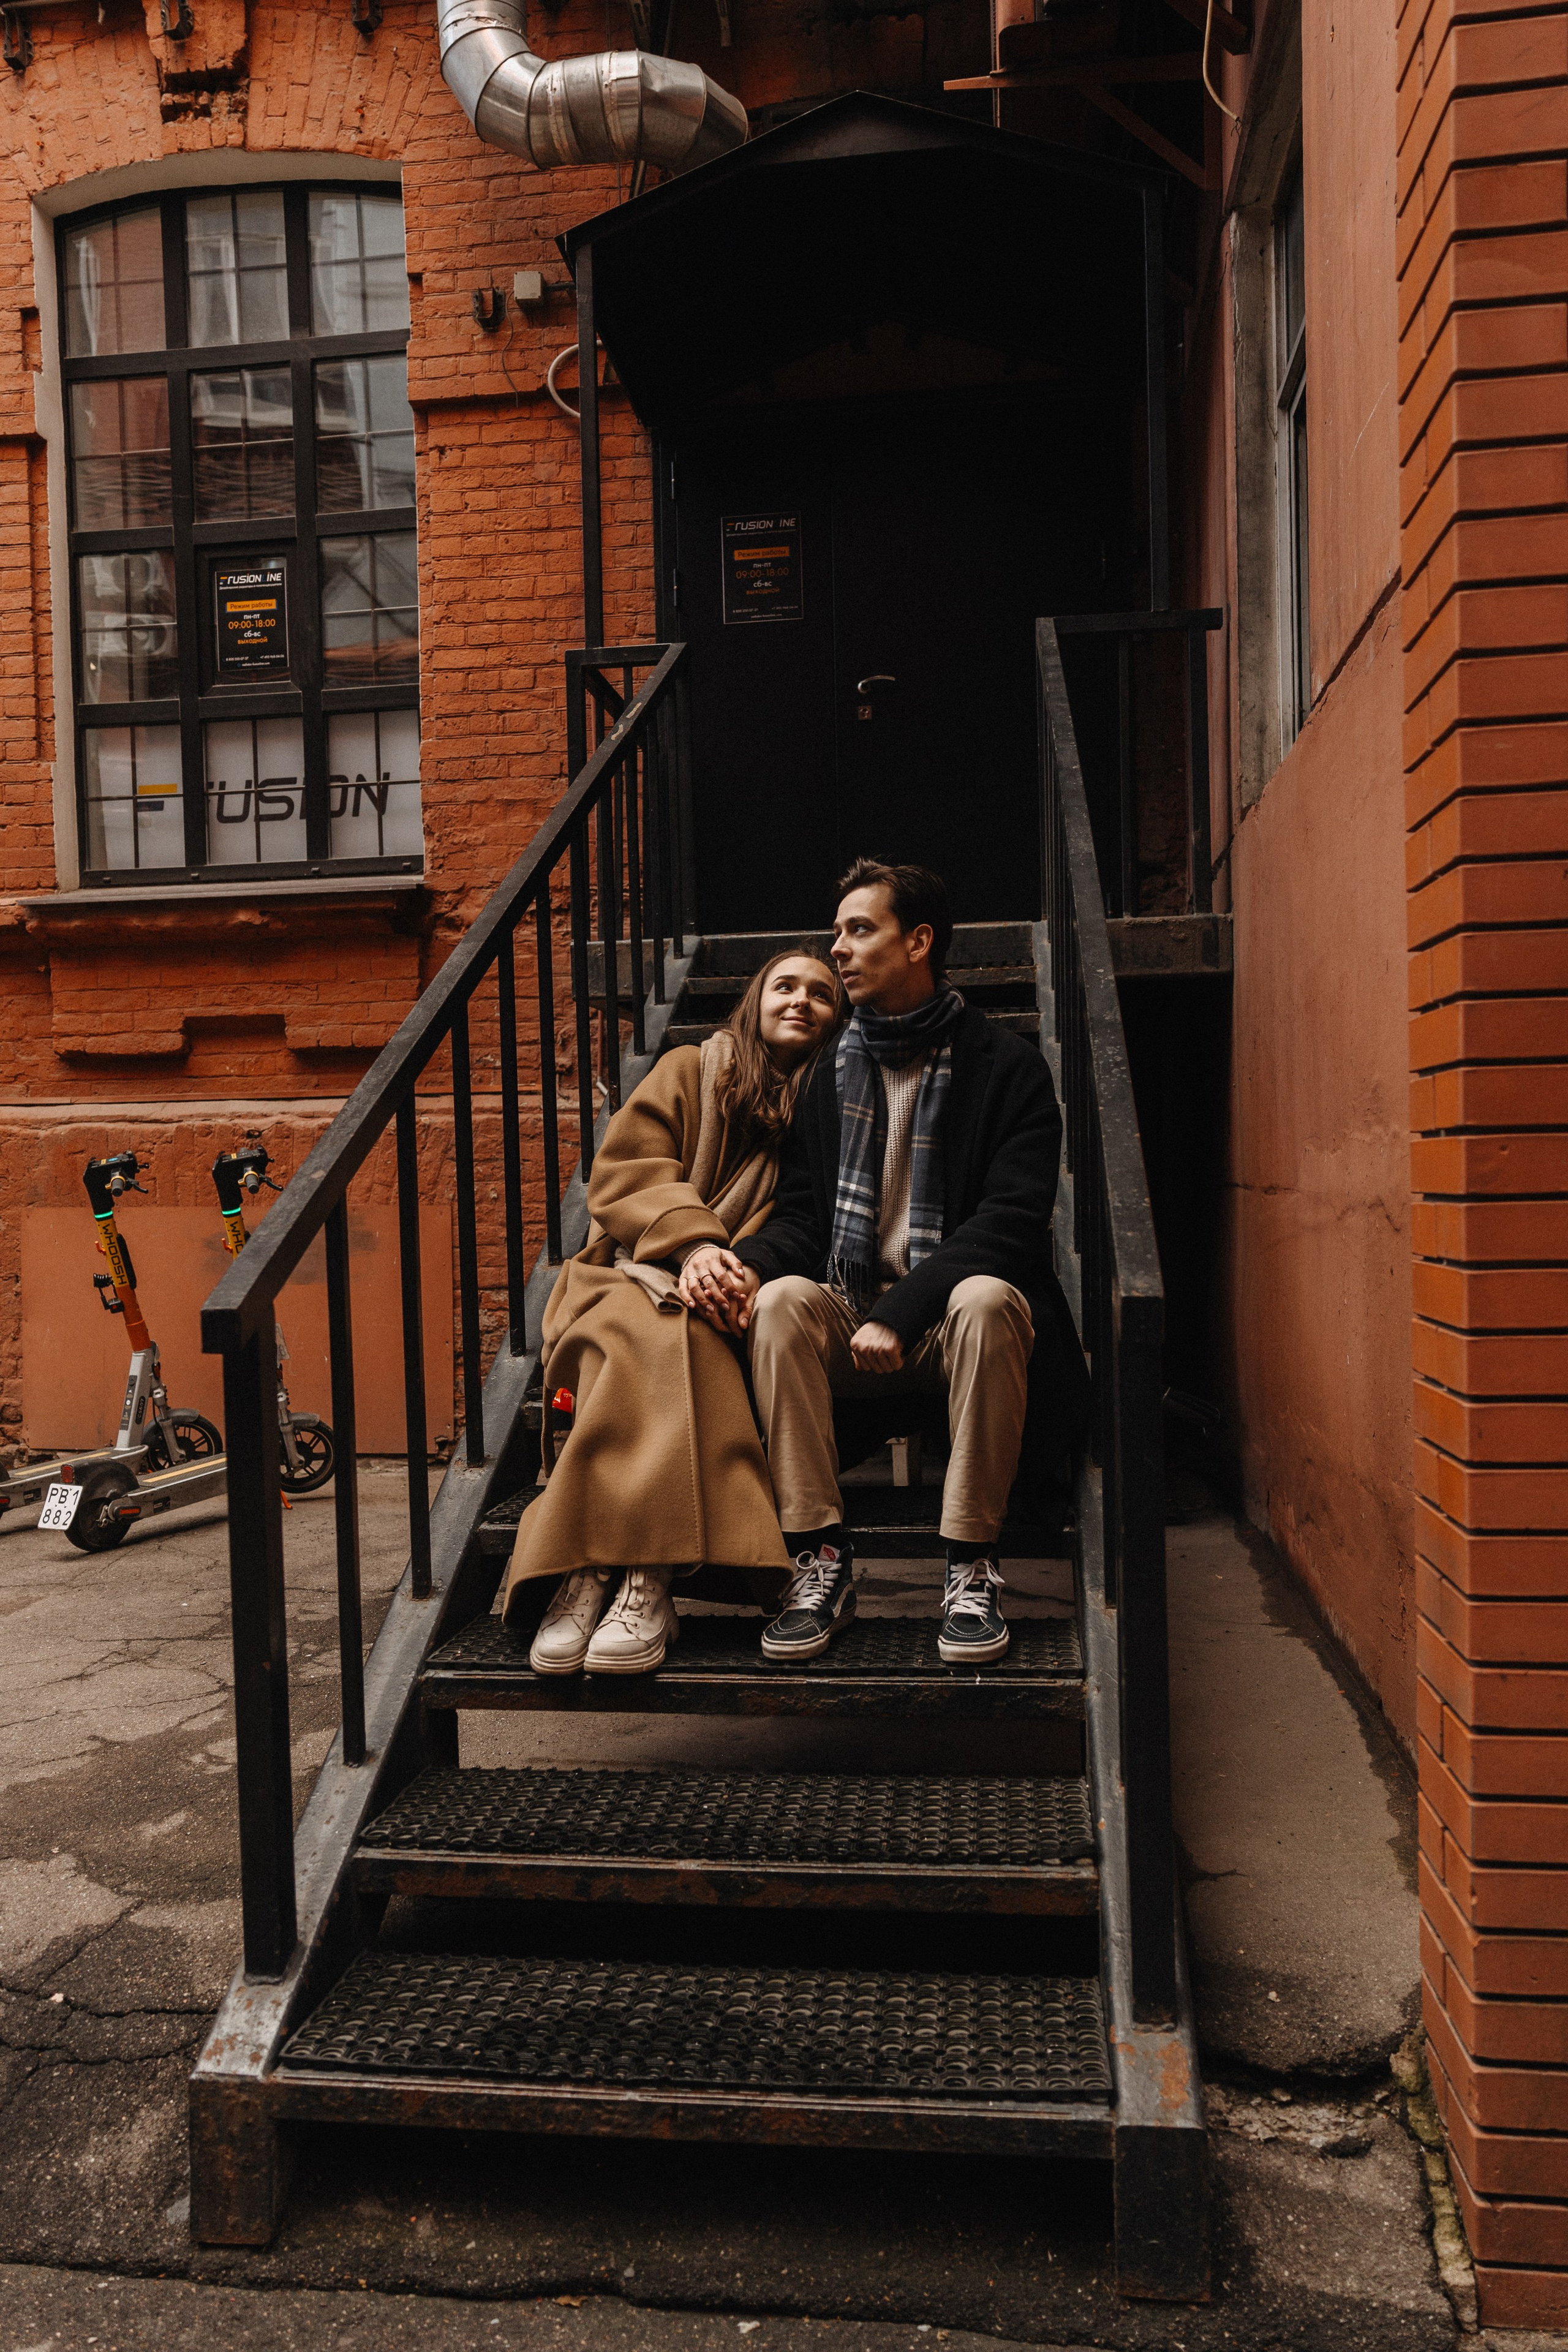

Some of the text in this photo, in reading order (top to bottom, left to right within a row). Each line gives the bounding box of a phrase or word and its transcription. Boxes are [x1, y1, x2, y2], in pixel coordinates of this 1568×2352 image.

[736, 567, 790, 579] 09:00-1800
[228, 619, 276, 629] 09:00-18:00
[102, 1224, 127, 1285] WHOOSH
[48, 1488, 79, 1505] PB1
[42, 1509, 72, 1526] 882
